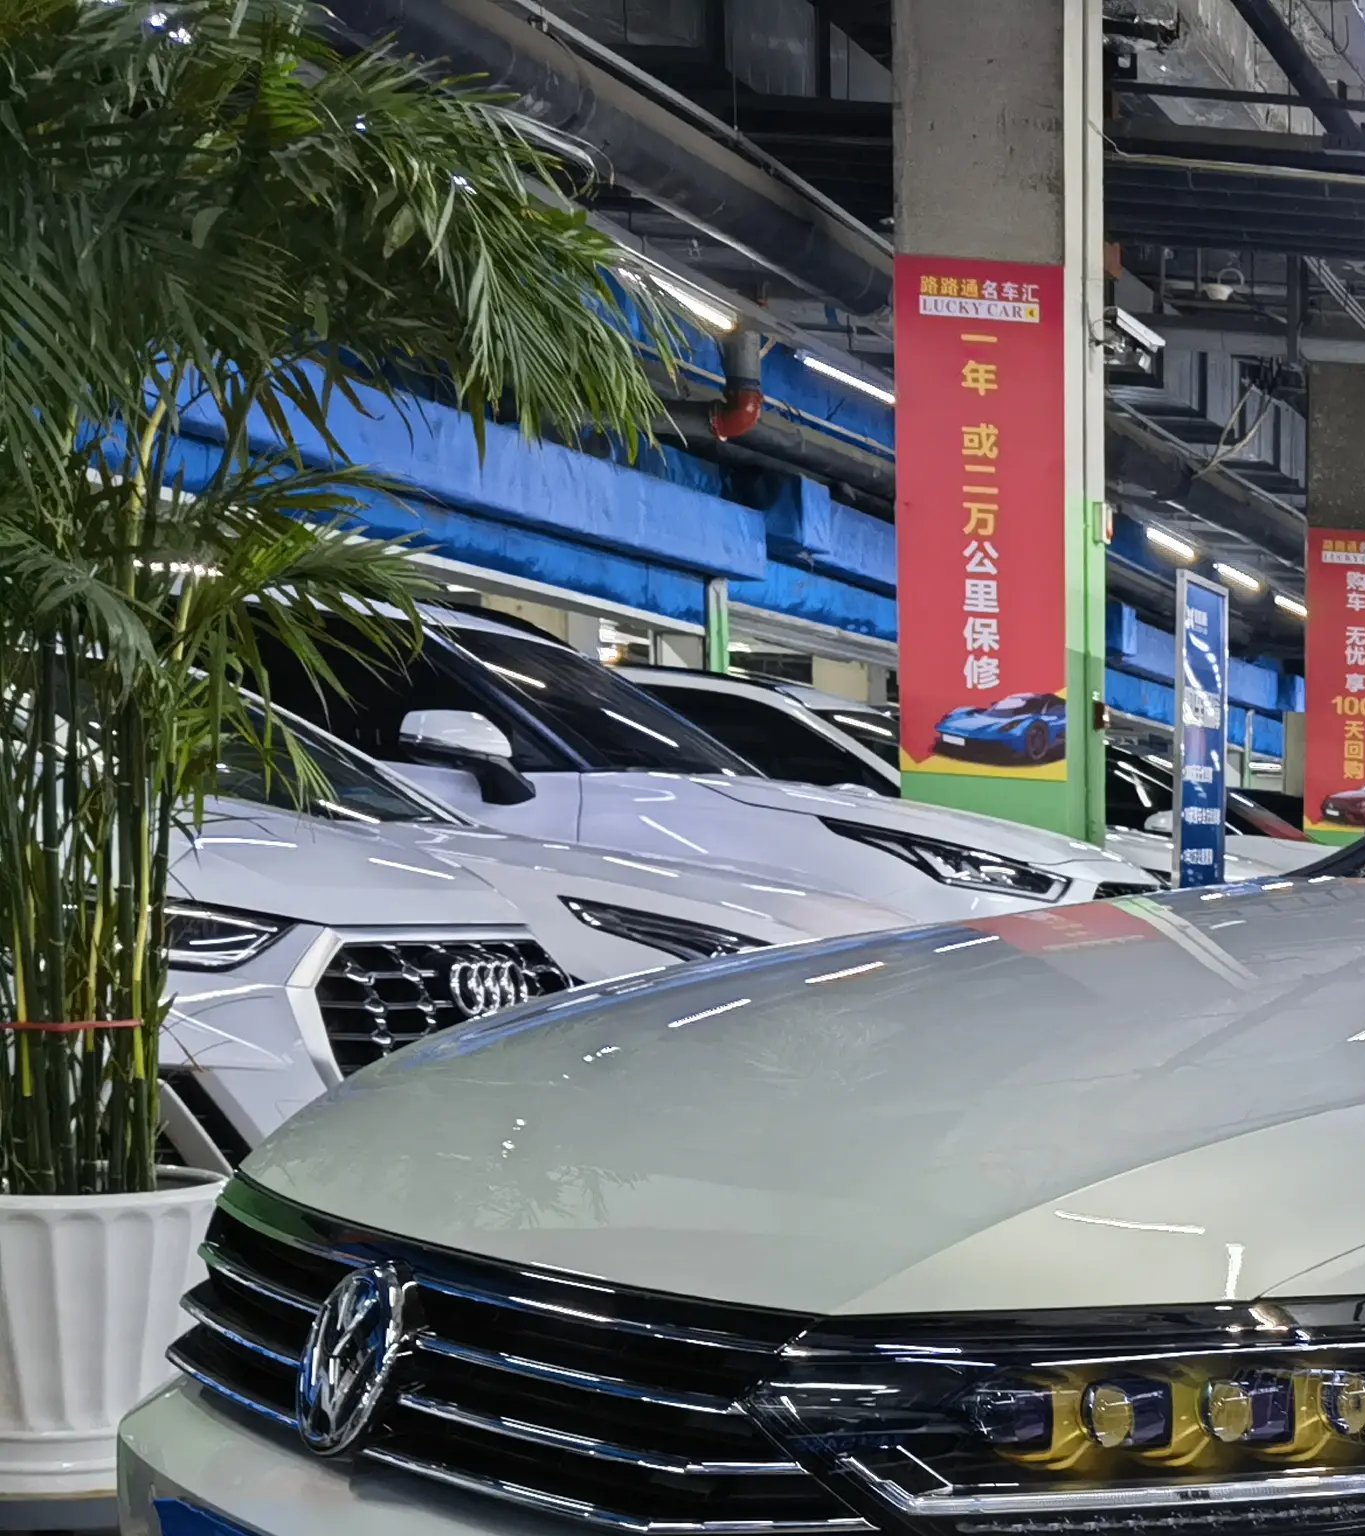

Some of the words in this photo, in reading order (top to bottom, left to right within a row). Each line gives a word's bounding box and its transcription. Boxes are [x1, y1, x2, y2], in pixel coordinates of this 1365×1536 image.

[920, 275, 1039, 302] 路路通名车汇
[922, 298, 982, 315] LUCKY
[986, 303, 1022, 319] CAR
